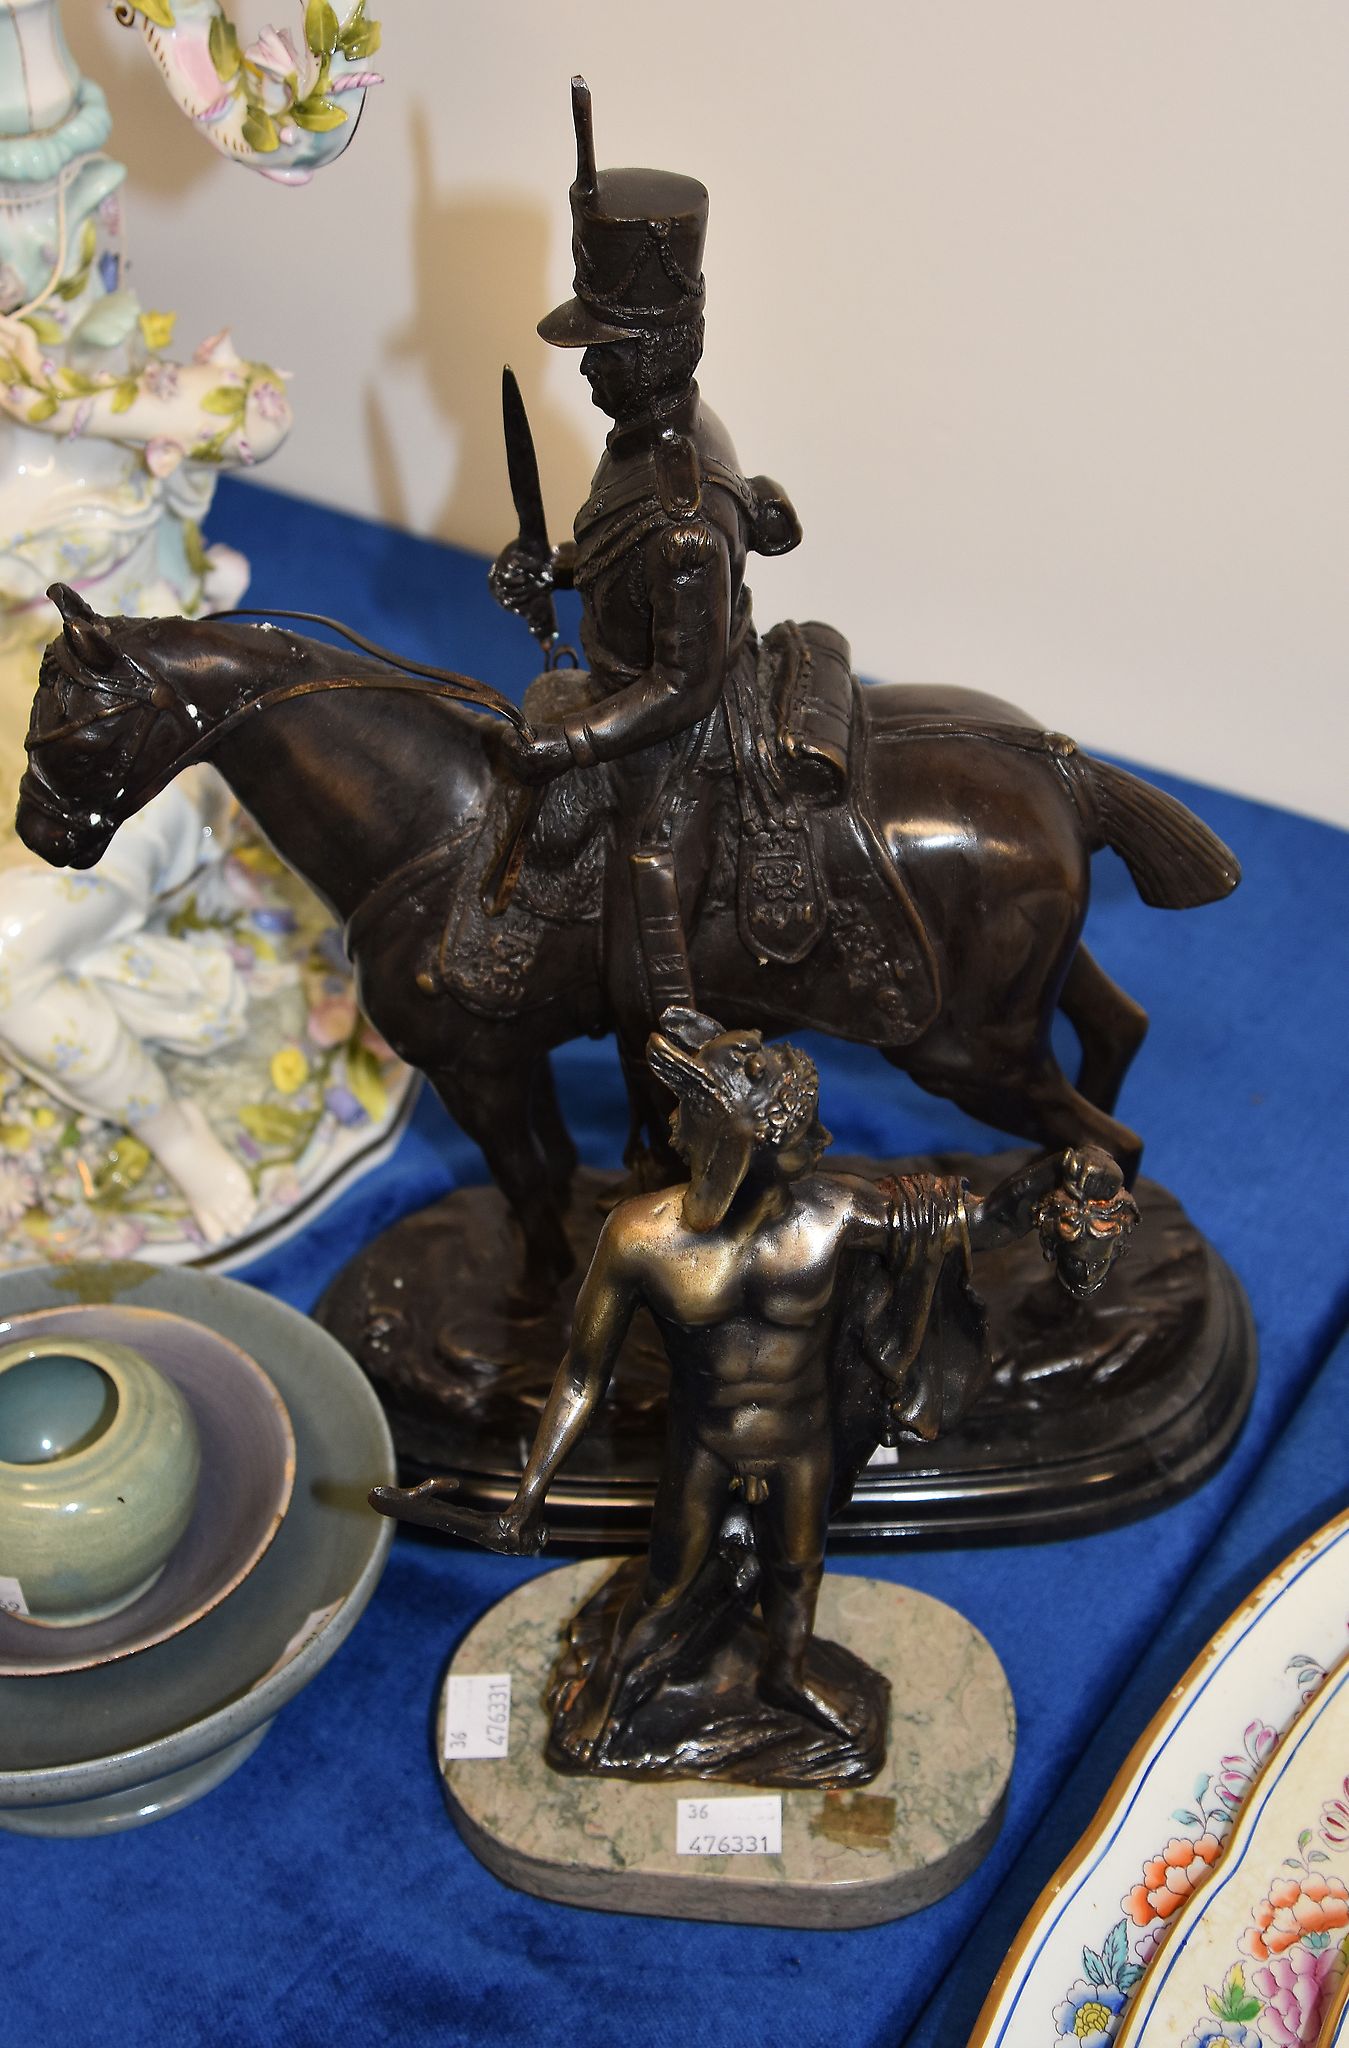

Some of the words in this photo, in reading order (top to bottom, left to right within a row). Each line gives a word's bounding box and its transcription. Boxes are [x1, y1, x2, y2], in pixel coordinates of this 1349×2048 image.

[486, 1683, 508, 1747] 476331
[449, 1732, 468, 1749] 36
[687, 1803, 709, 1820] 36
[688, 1835, 768, 1853] 476331
